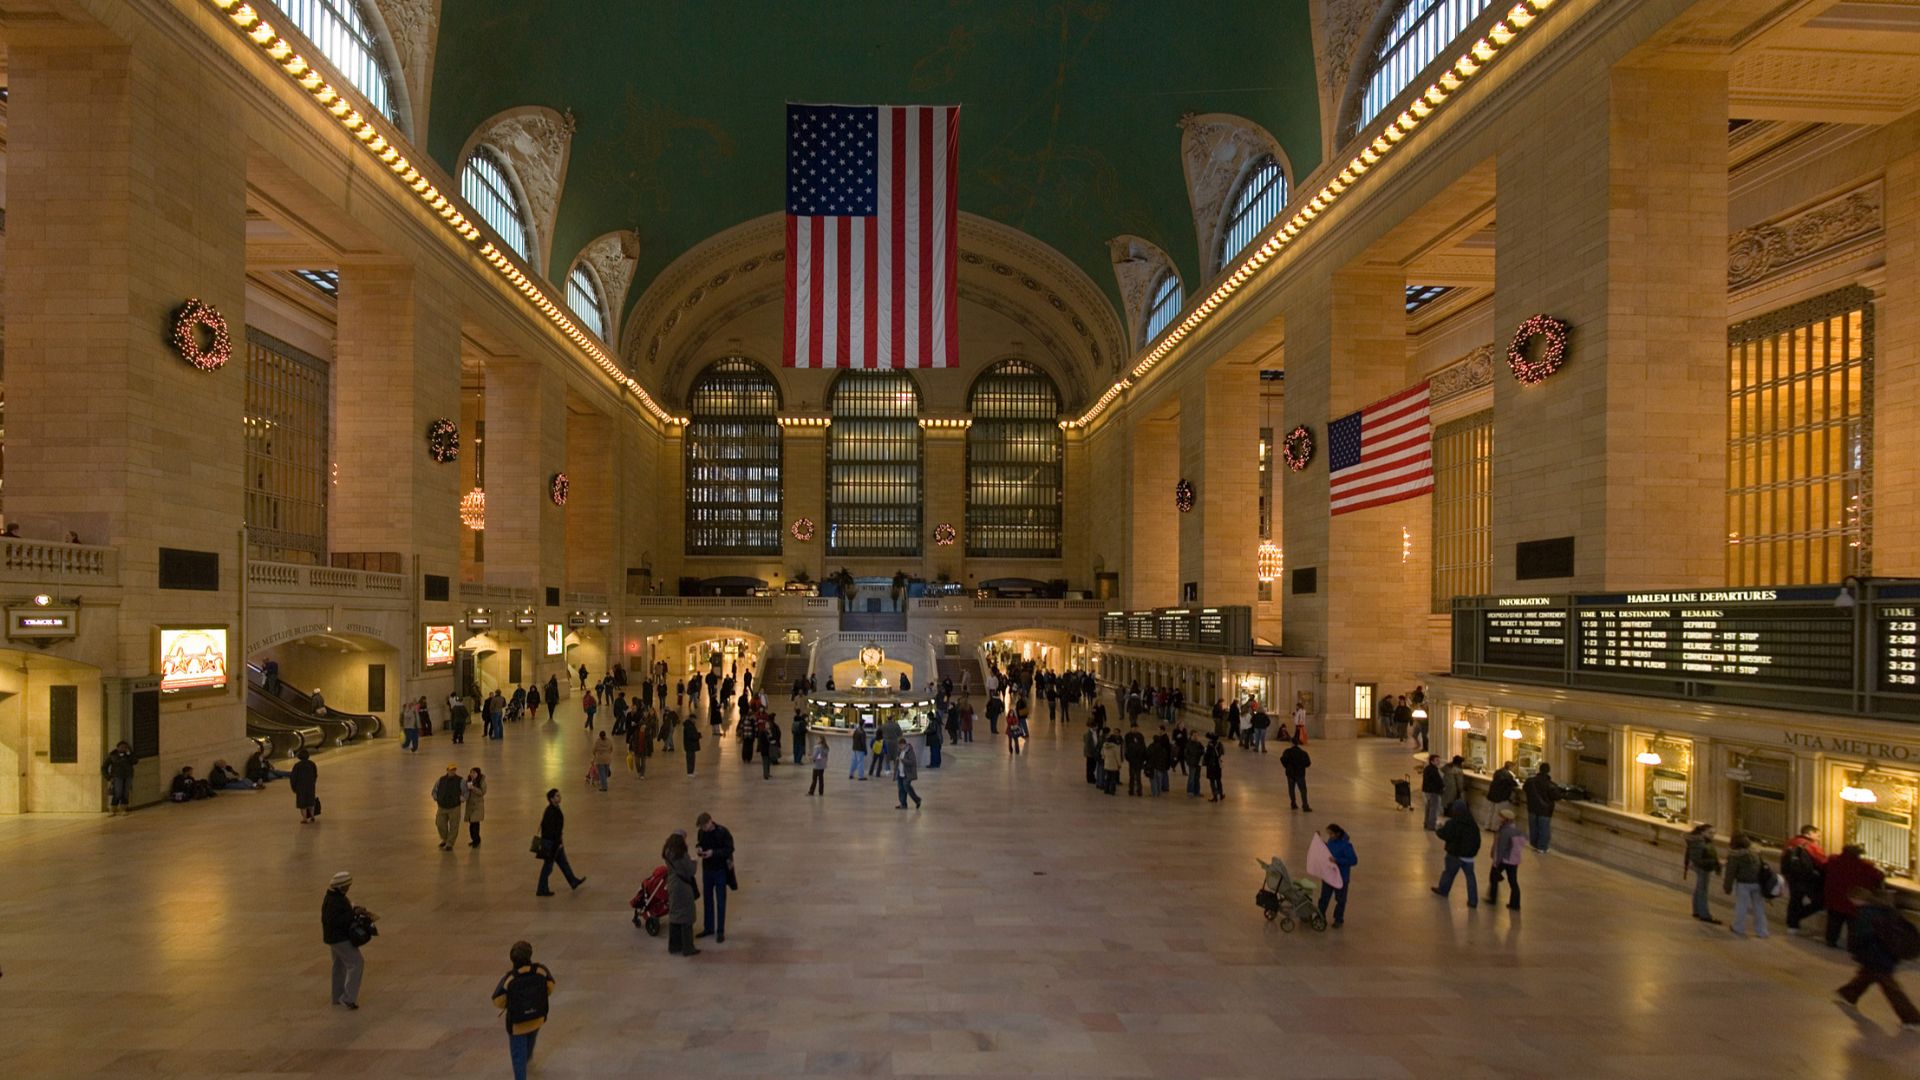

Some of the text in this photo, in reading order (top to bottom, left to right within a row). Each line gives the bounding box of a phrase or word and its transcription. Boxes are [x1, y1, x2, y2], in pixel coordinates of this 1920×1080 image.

[1499, 598, 1550, 606] INFORMATION
[1627, 591, 1777, 604] HARLEM LINE DEPARTURES
[1883, 608, 1915, 617] TIME
[1889, 622, 1916, 631] 2:23
[1739, 644, 1759, 652] STOP
[1889, 648, 1916, 658] 3:02
[1739, 666, 1759, 674] STOP
[1889, 661, 1916, 671] 3:23
[1784, 731, 1824, 749] MTA
